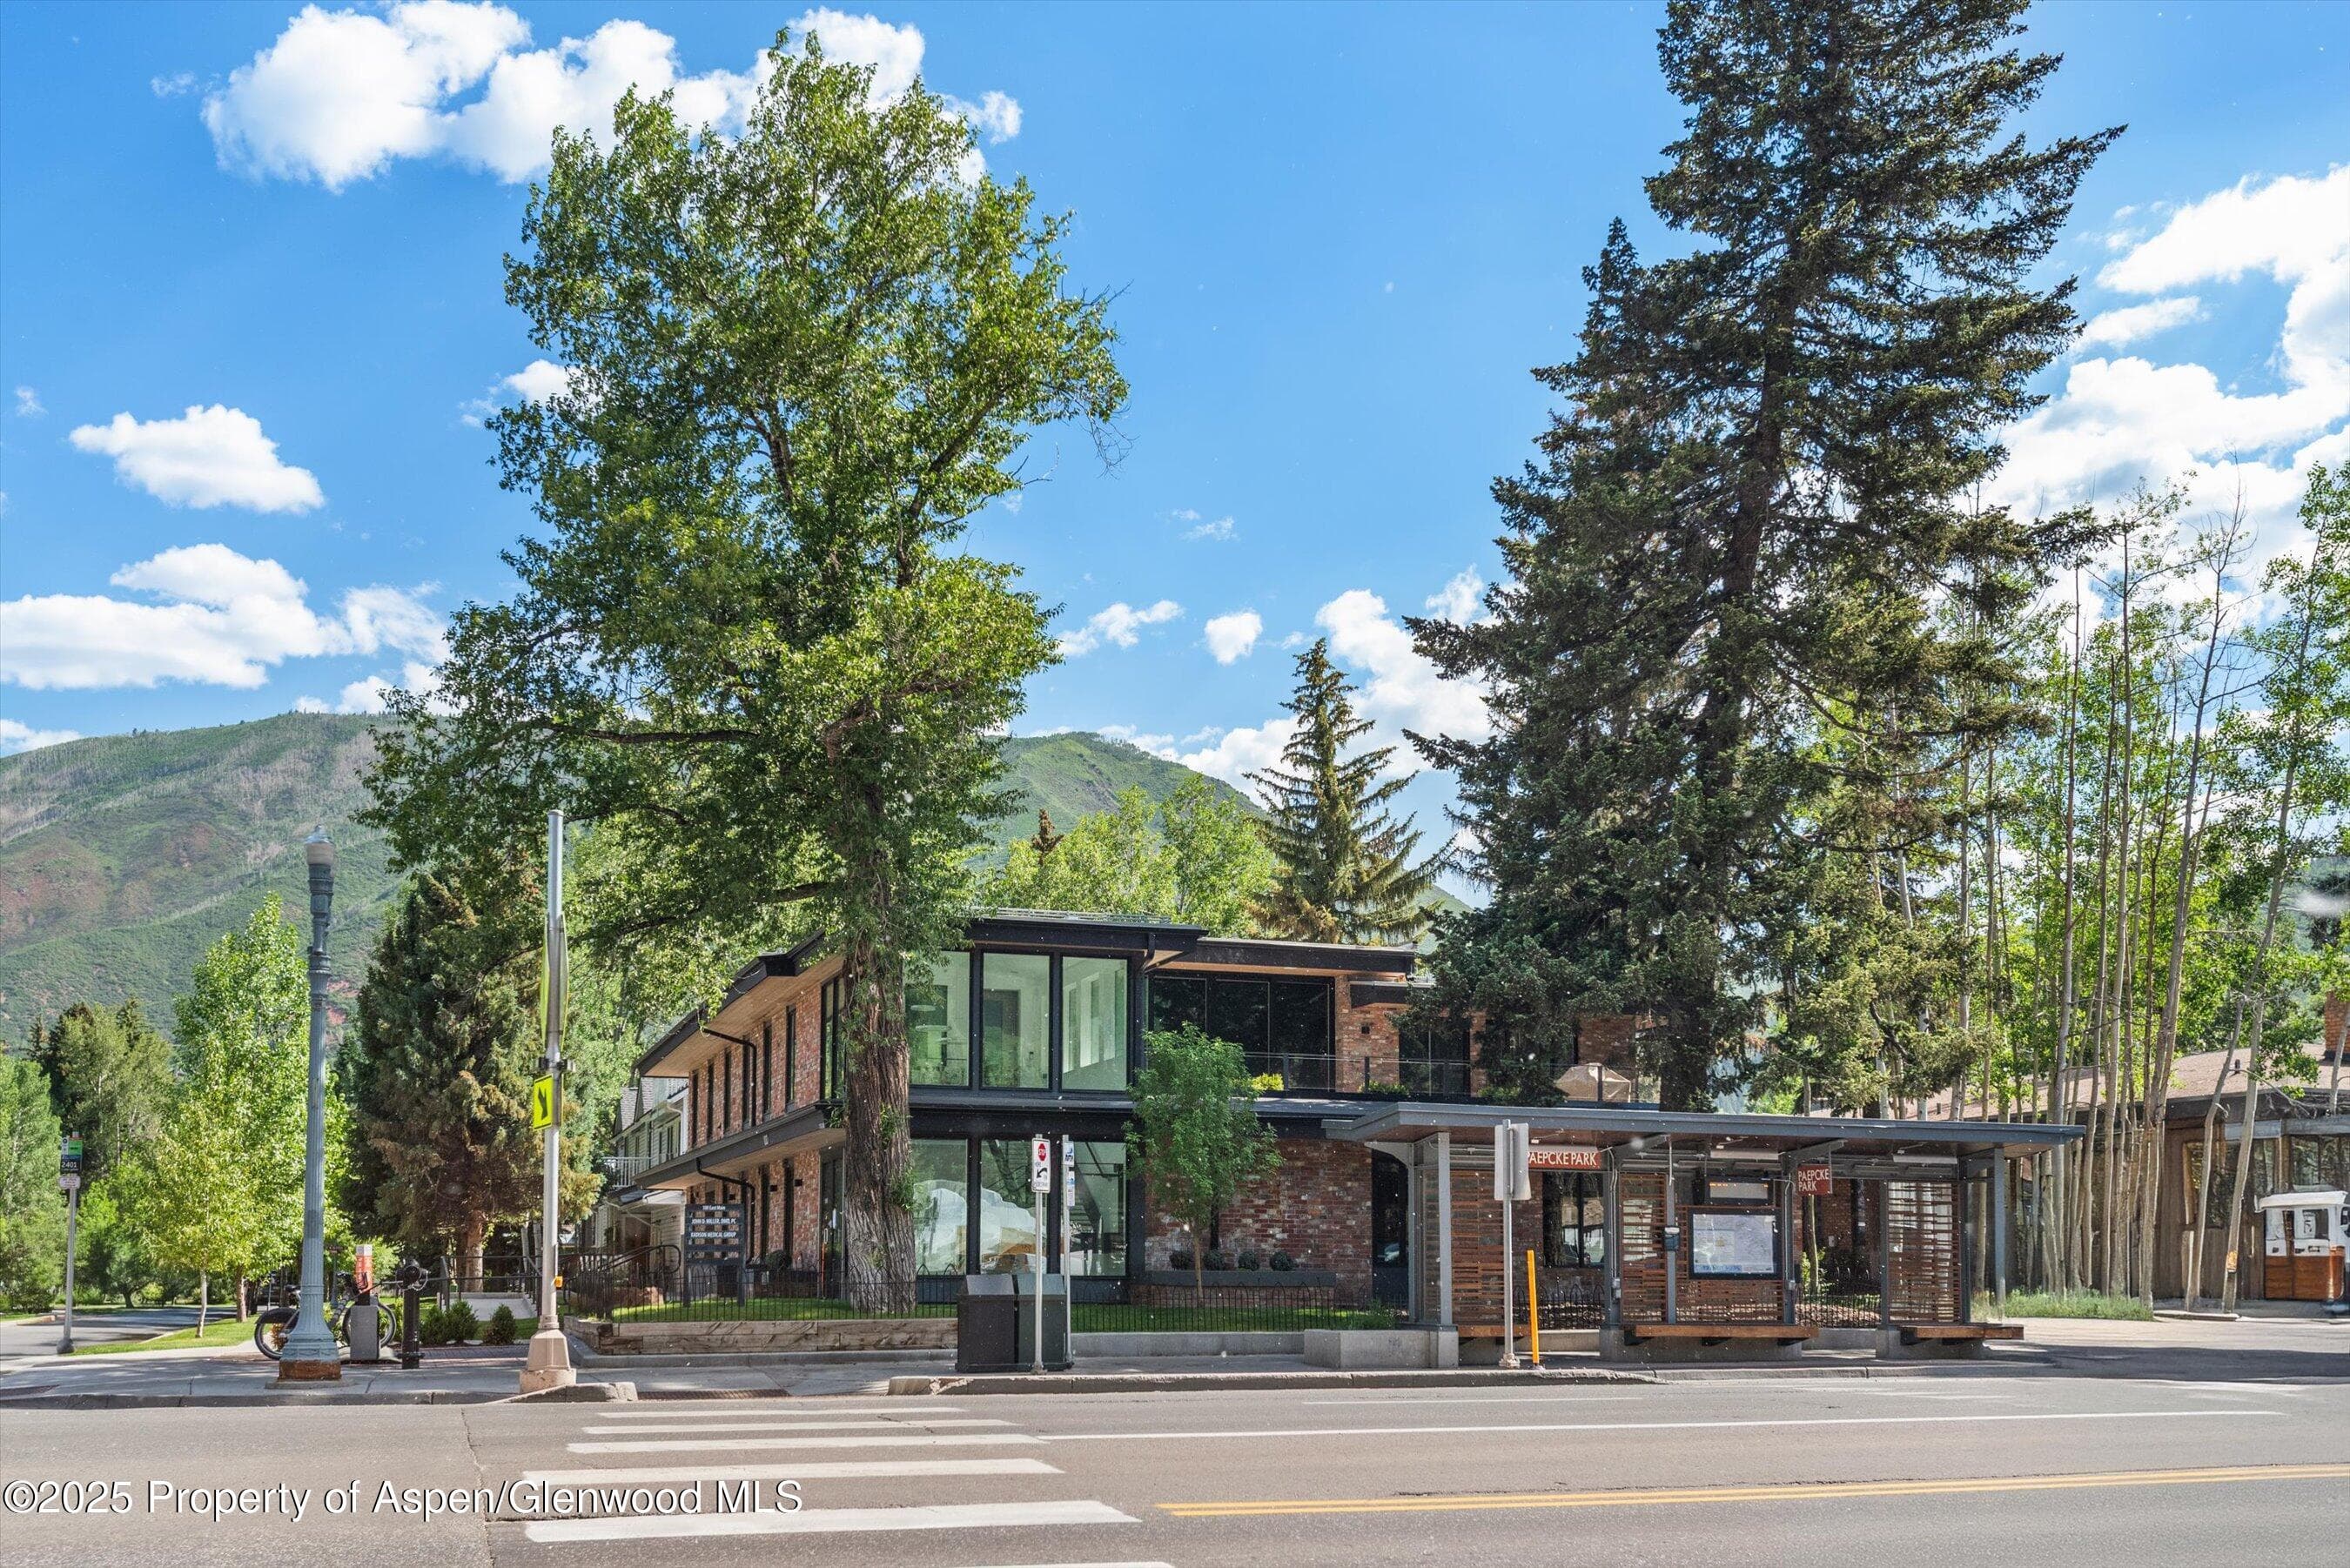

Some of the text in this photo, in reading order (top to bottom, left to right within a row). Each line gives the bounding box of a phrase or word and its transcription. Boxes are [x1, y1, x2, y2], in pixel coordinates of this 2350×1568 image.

[1570, 1153, 1597, 1166] PARK
[1797, 1169, 1830, 1182] PAEPCKE
[1798, 1180, 1817, 1192] PARK
